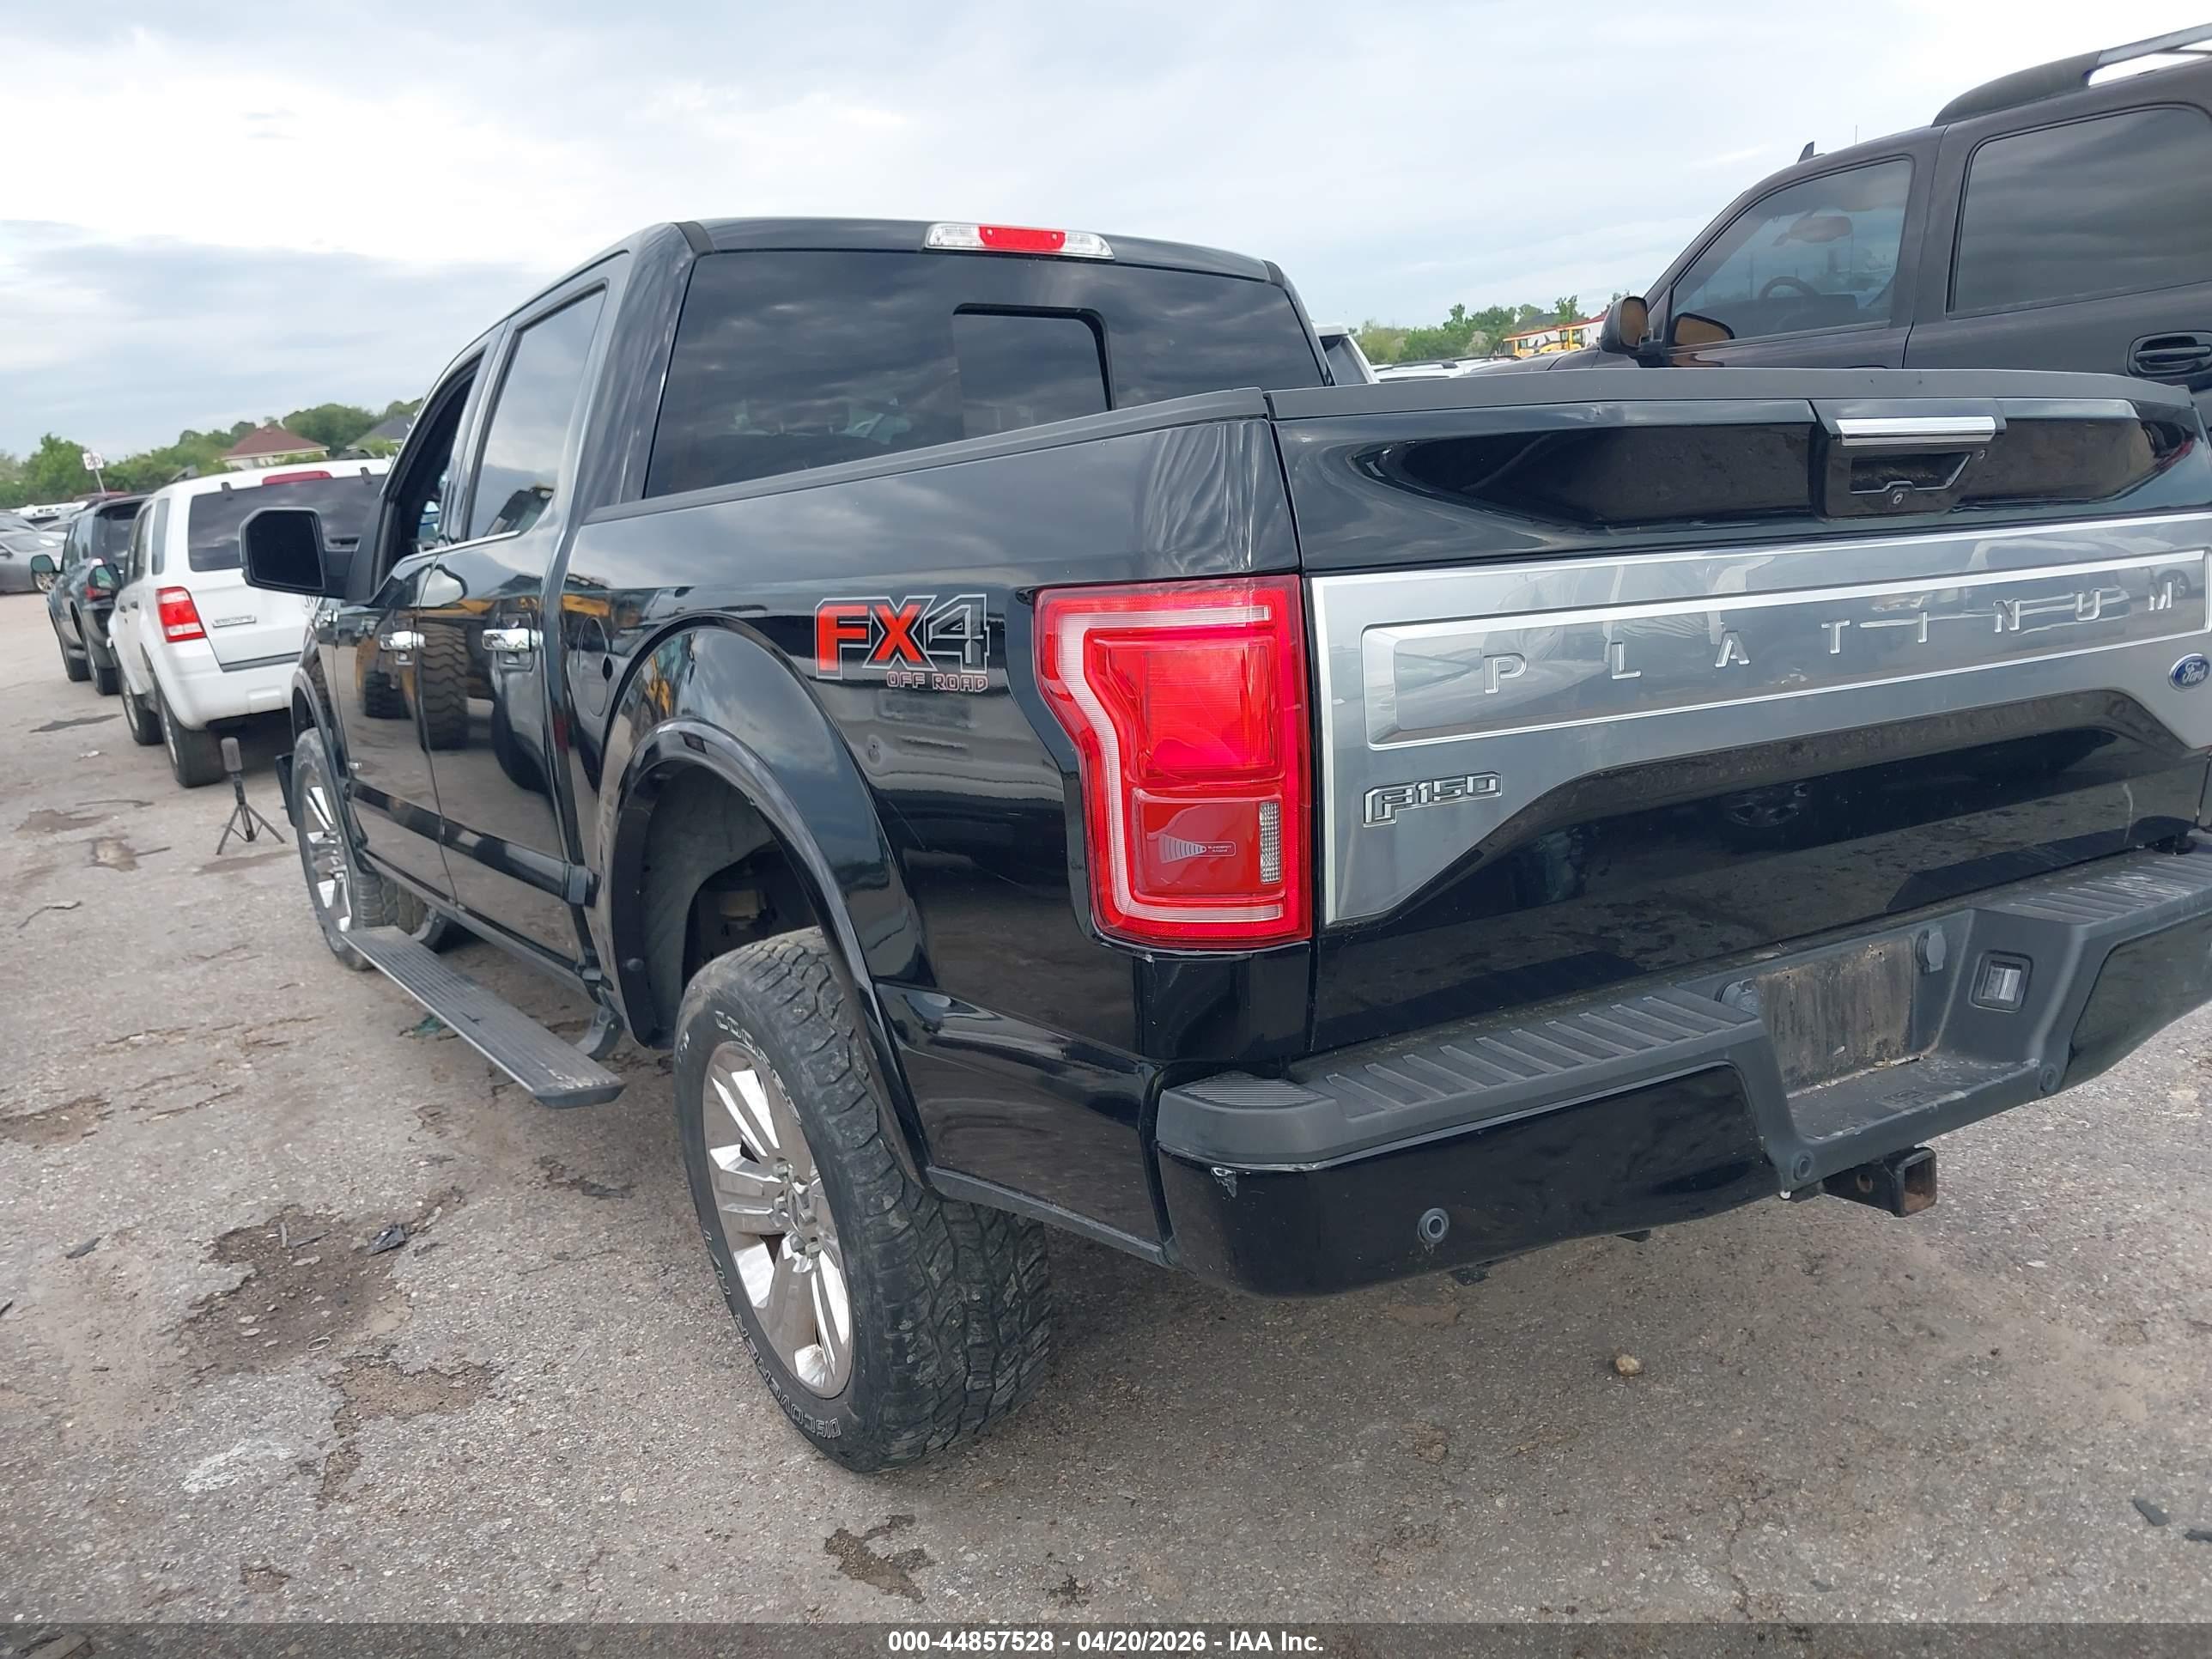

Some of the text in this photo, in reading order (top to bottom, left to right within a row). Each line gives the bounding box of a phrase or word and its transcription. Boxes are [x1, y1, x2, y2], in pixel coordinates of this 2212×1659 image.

[815, 593, 990, 680] FX4
[1483, 580, 2172, 694] PLATINUM
[2182, 661, 2206, 683] Ford
[886, 671, 988, 692] OFF ROAD
[732, 1311, 842, 1440] DISCOVERER
